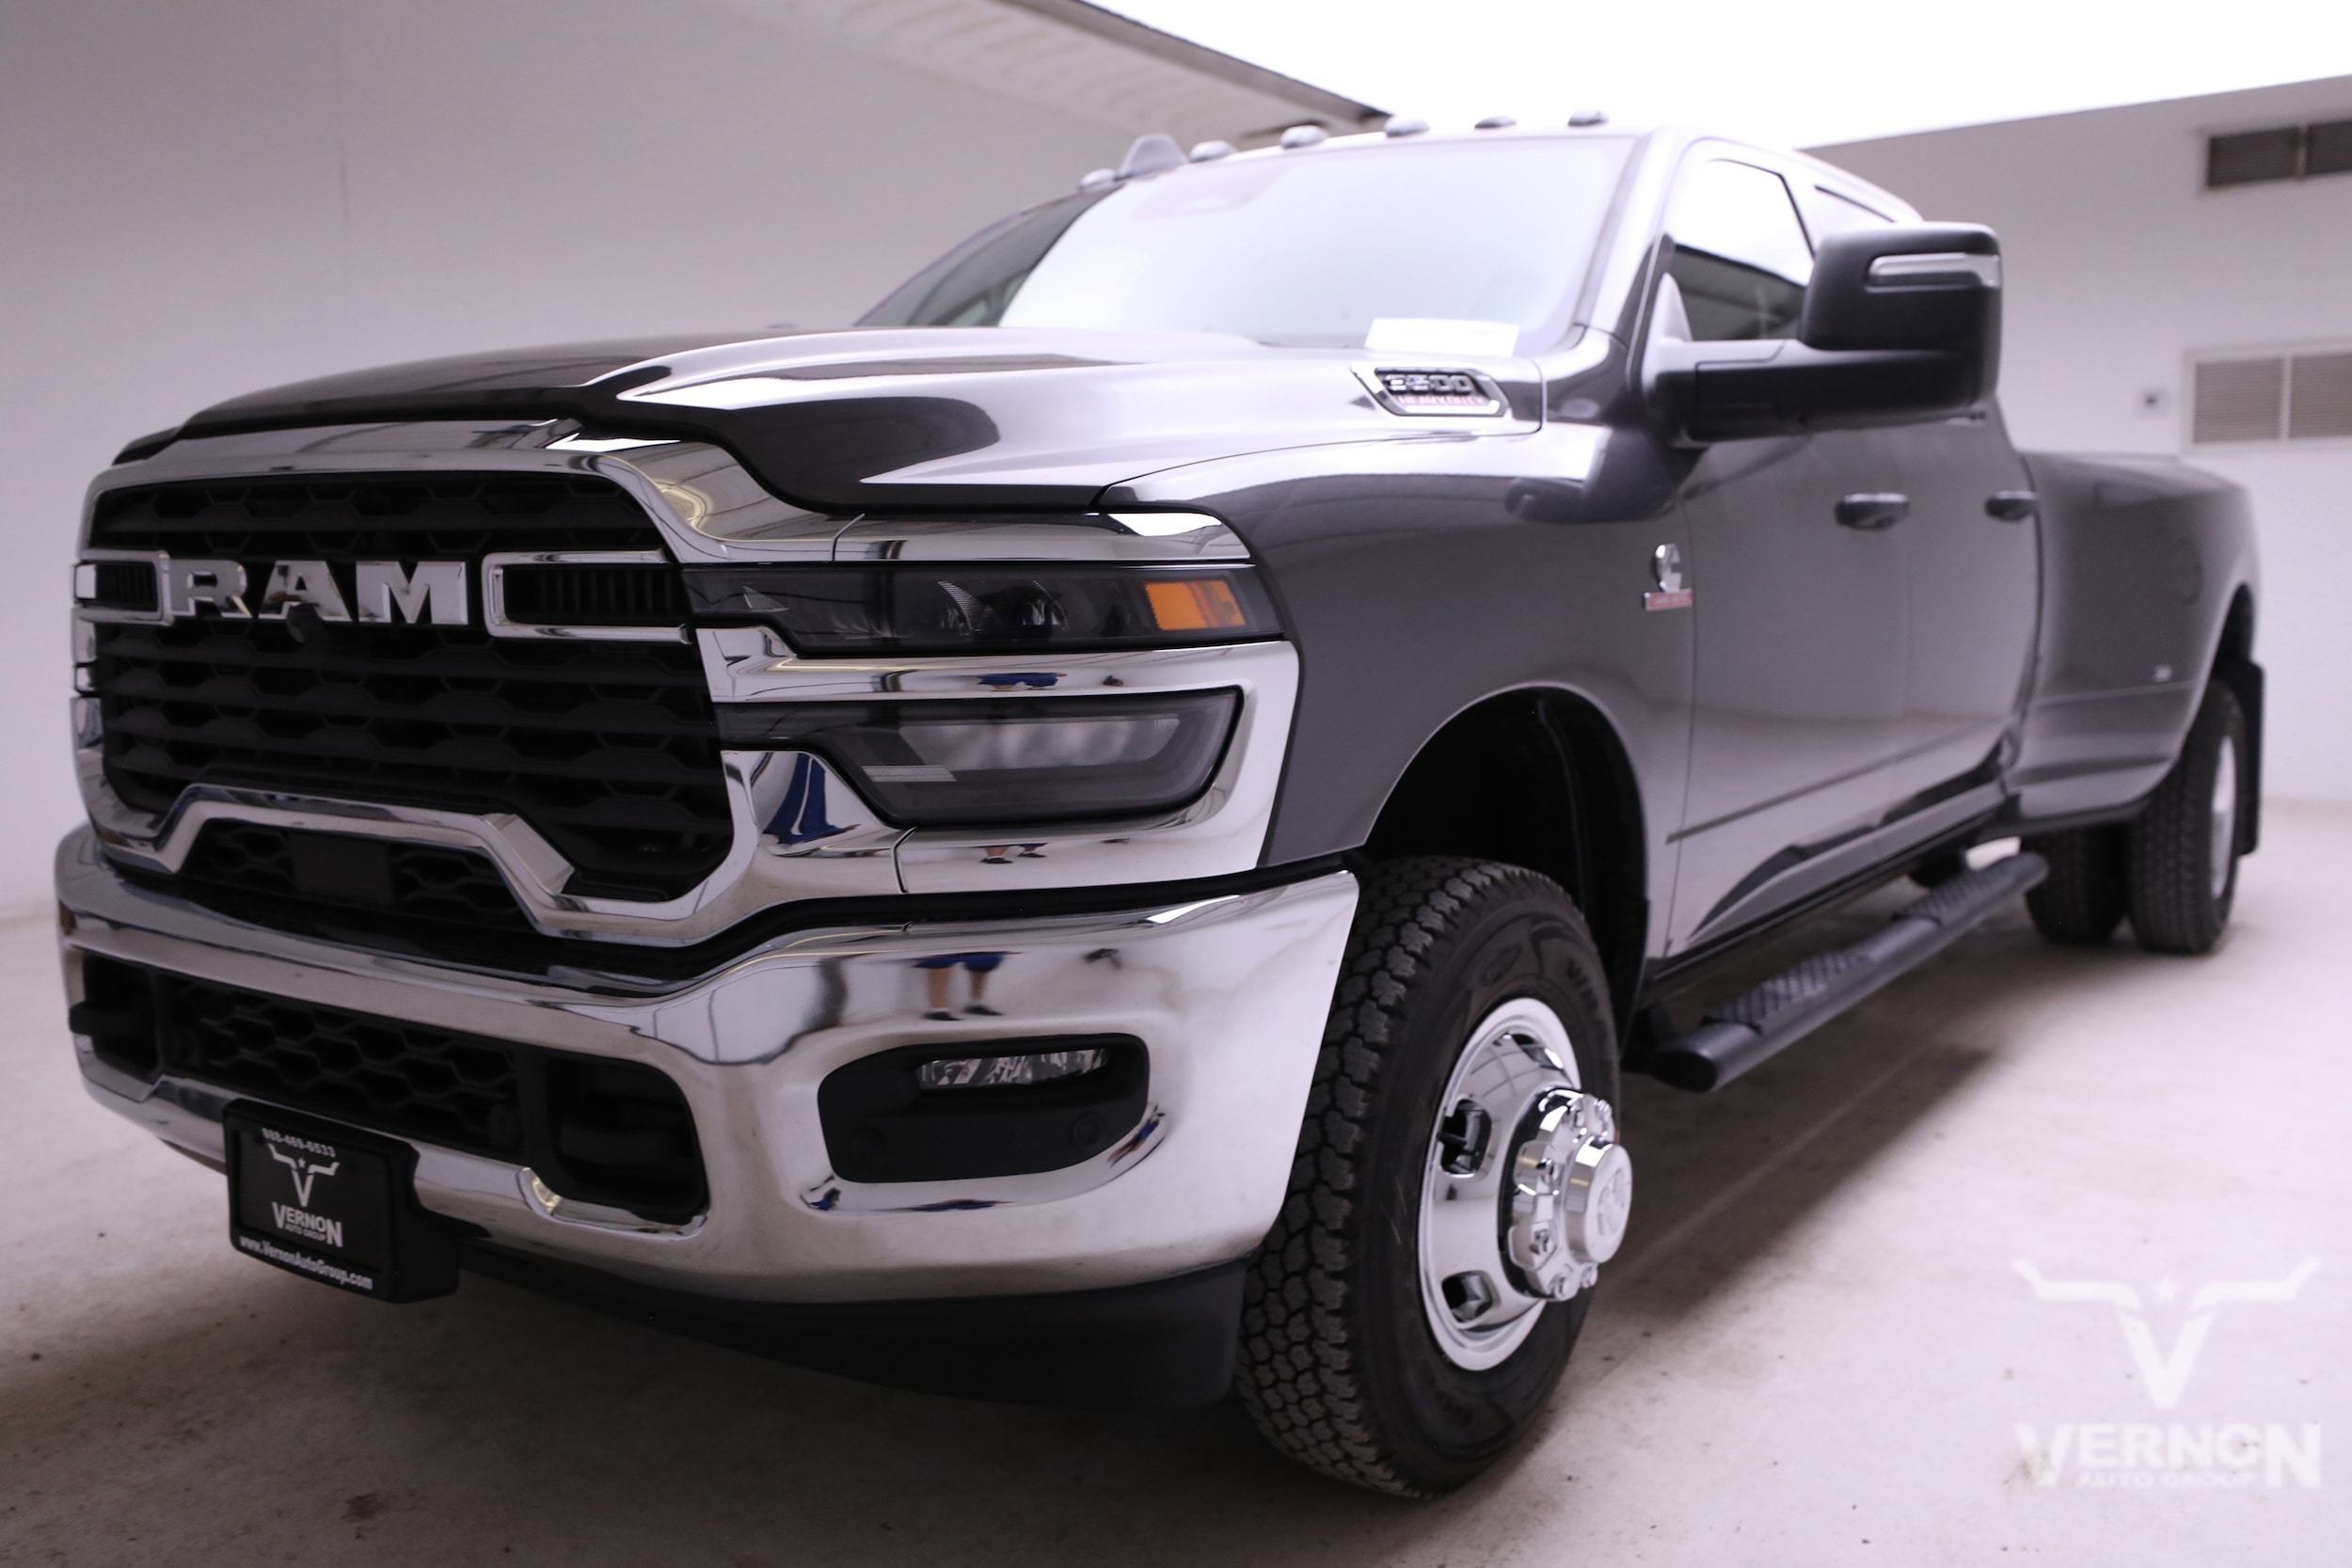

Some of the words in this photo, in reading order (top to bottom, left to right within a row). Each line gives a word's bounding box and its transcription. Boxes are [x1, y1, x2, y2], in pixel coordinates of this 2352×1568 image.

[168, 559, 469, 626] RAM
[271, 1201, 343, 1247] VERNON
[239, 1235, 373, 1291] www.VernonAutoGroup.com
